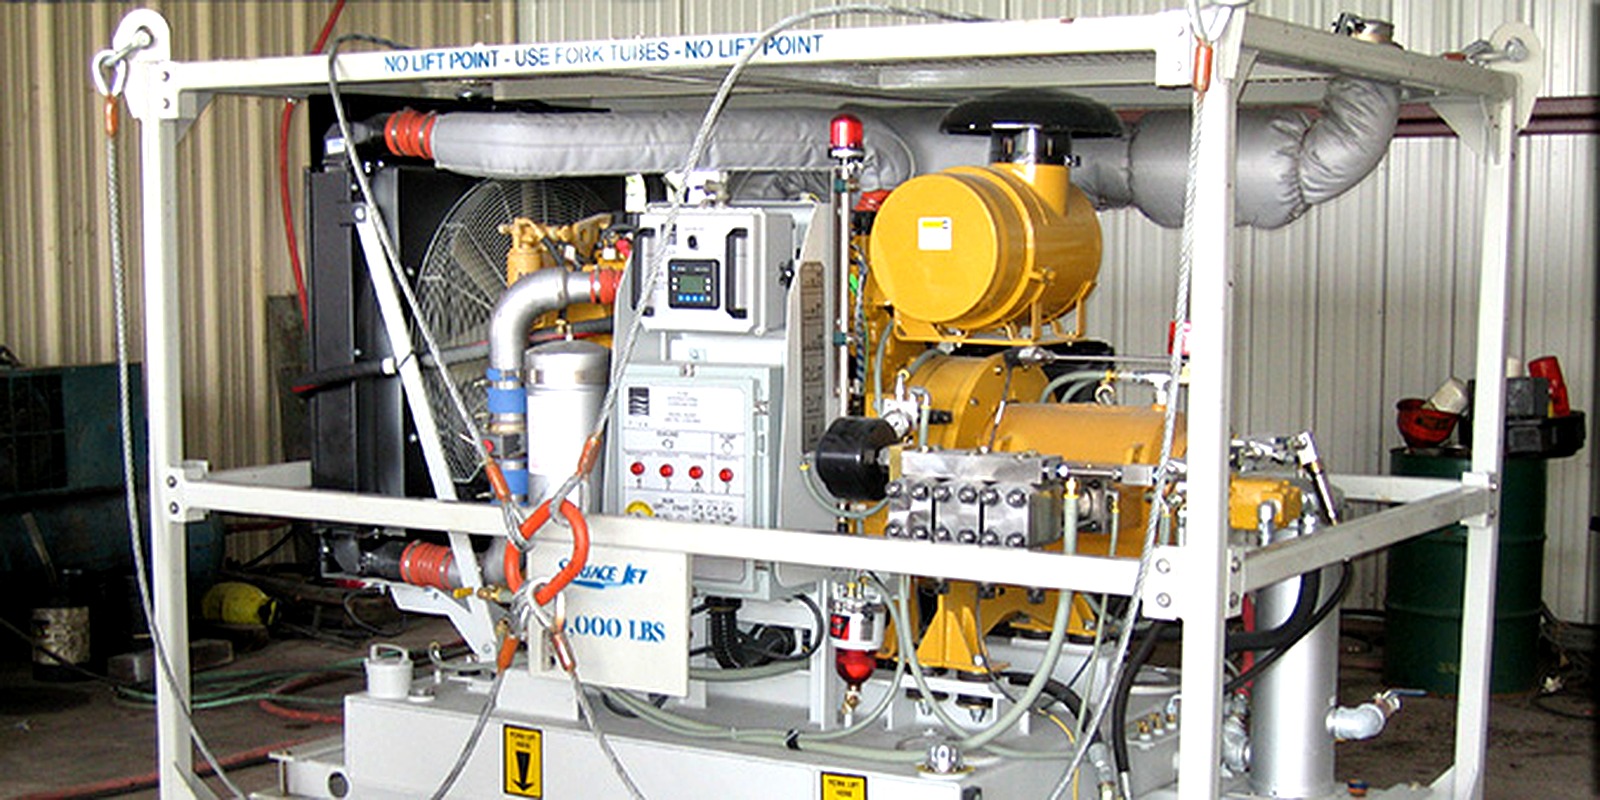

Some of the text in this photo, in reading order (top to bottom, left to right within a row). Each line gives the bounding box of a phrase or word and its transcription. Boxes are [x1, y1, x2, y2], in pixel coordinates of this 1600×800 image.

[384, 56, 408, 73] NO
[413, 53, 444, 72] LIFT
[450, 50, 498, 70] POINT
[515, 48, 550, 66] USE
[555, 46, 604, 65] FORK
[610, 43, 668, 62] TUBES
[686, 40, 714, 59] NO
[718, 38, 756, 58] LIFT
[764, 34, 824, 56] POINT
[622, 563, 648, 585] JET
[564, 616, 666, 642] ,000 LBS
